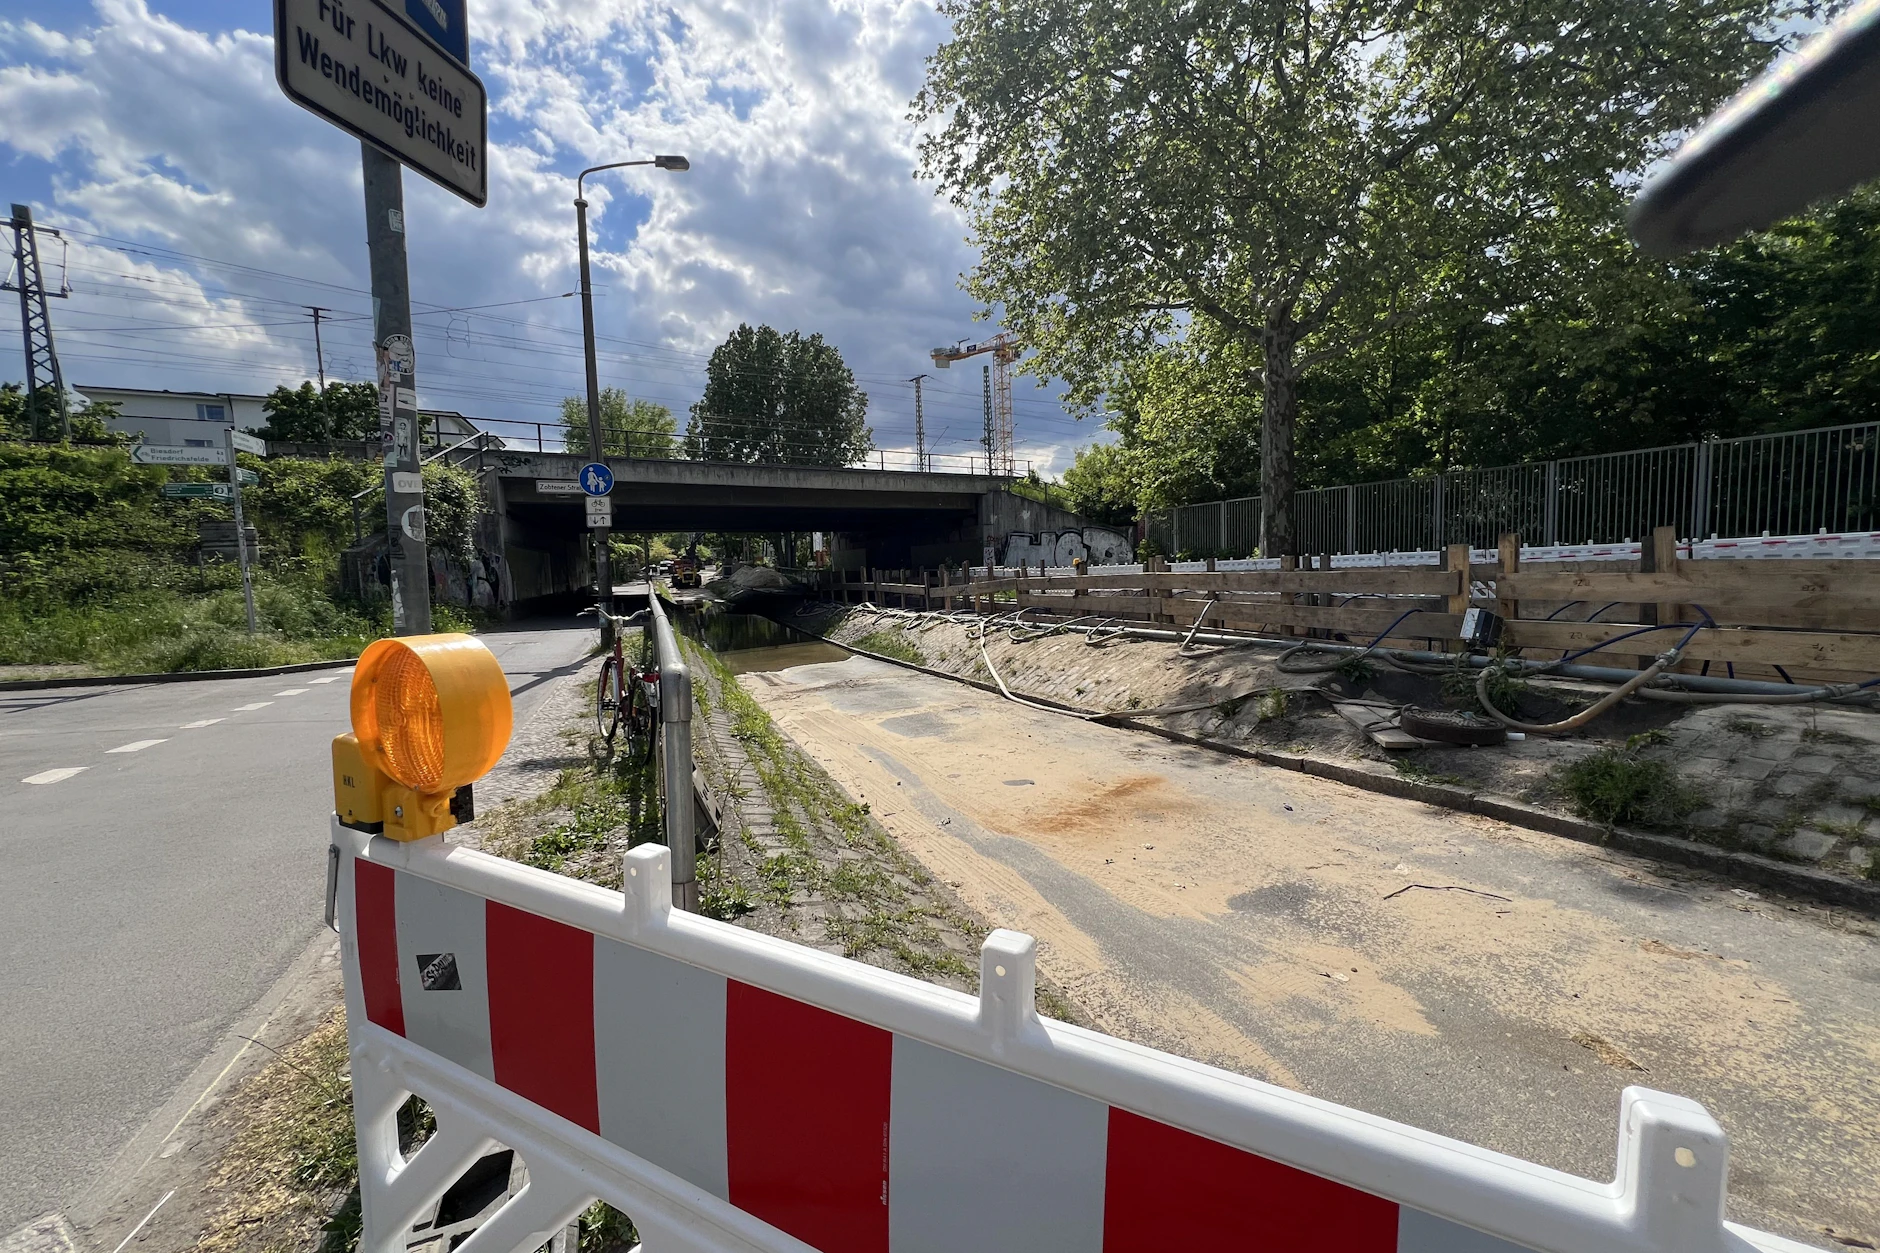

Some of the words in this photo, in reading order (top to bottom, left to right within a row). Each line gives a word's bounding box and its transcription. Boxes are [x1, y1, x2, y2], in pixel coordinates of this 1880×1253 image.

[297, 27, 476, 171] Wendemöglichkeit
[318, 0, 356, 41] Für
[368, 23, 407, 78] Lkw
[418, 61, 462, 118] keine
